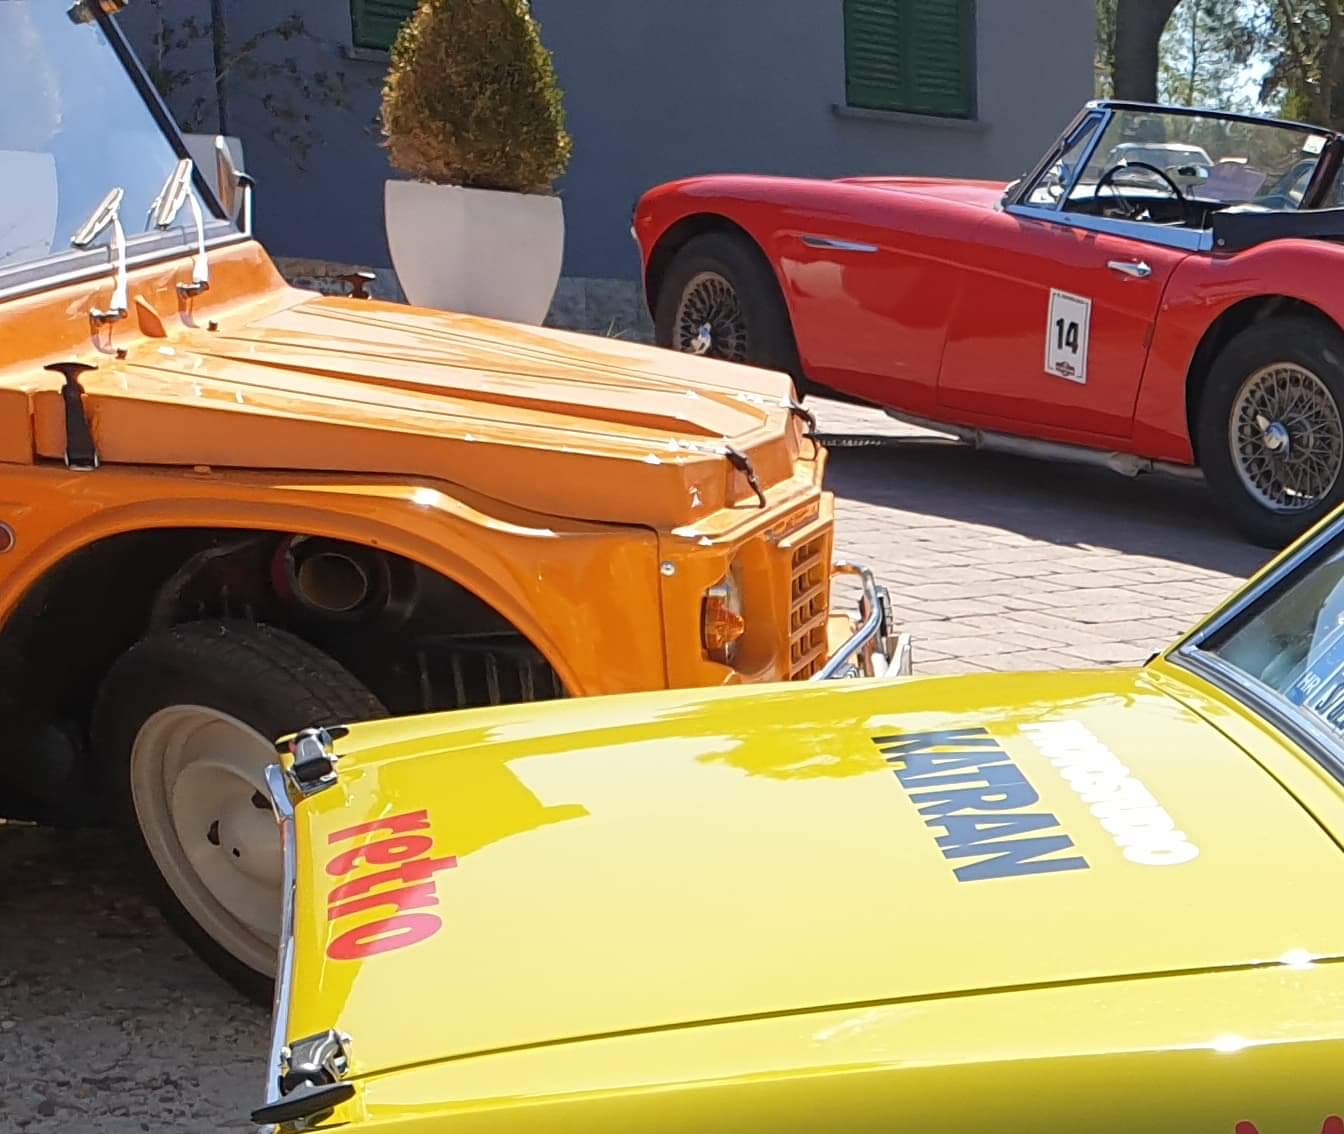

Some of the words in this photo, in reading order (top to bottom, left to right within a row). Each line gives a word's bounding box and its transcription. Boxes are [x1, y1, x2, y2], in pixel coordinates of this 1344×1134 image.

[1056, 318, 1079, 354] 14
[1299, 671, 1321, 697] HR
[871, 727, 1091, 883] KATRAN
[325, 808, 458, 961] retro
